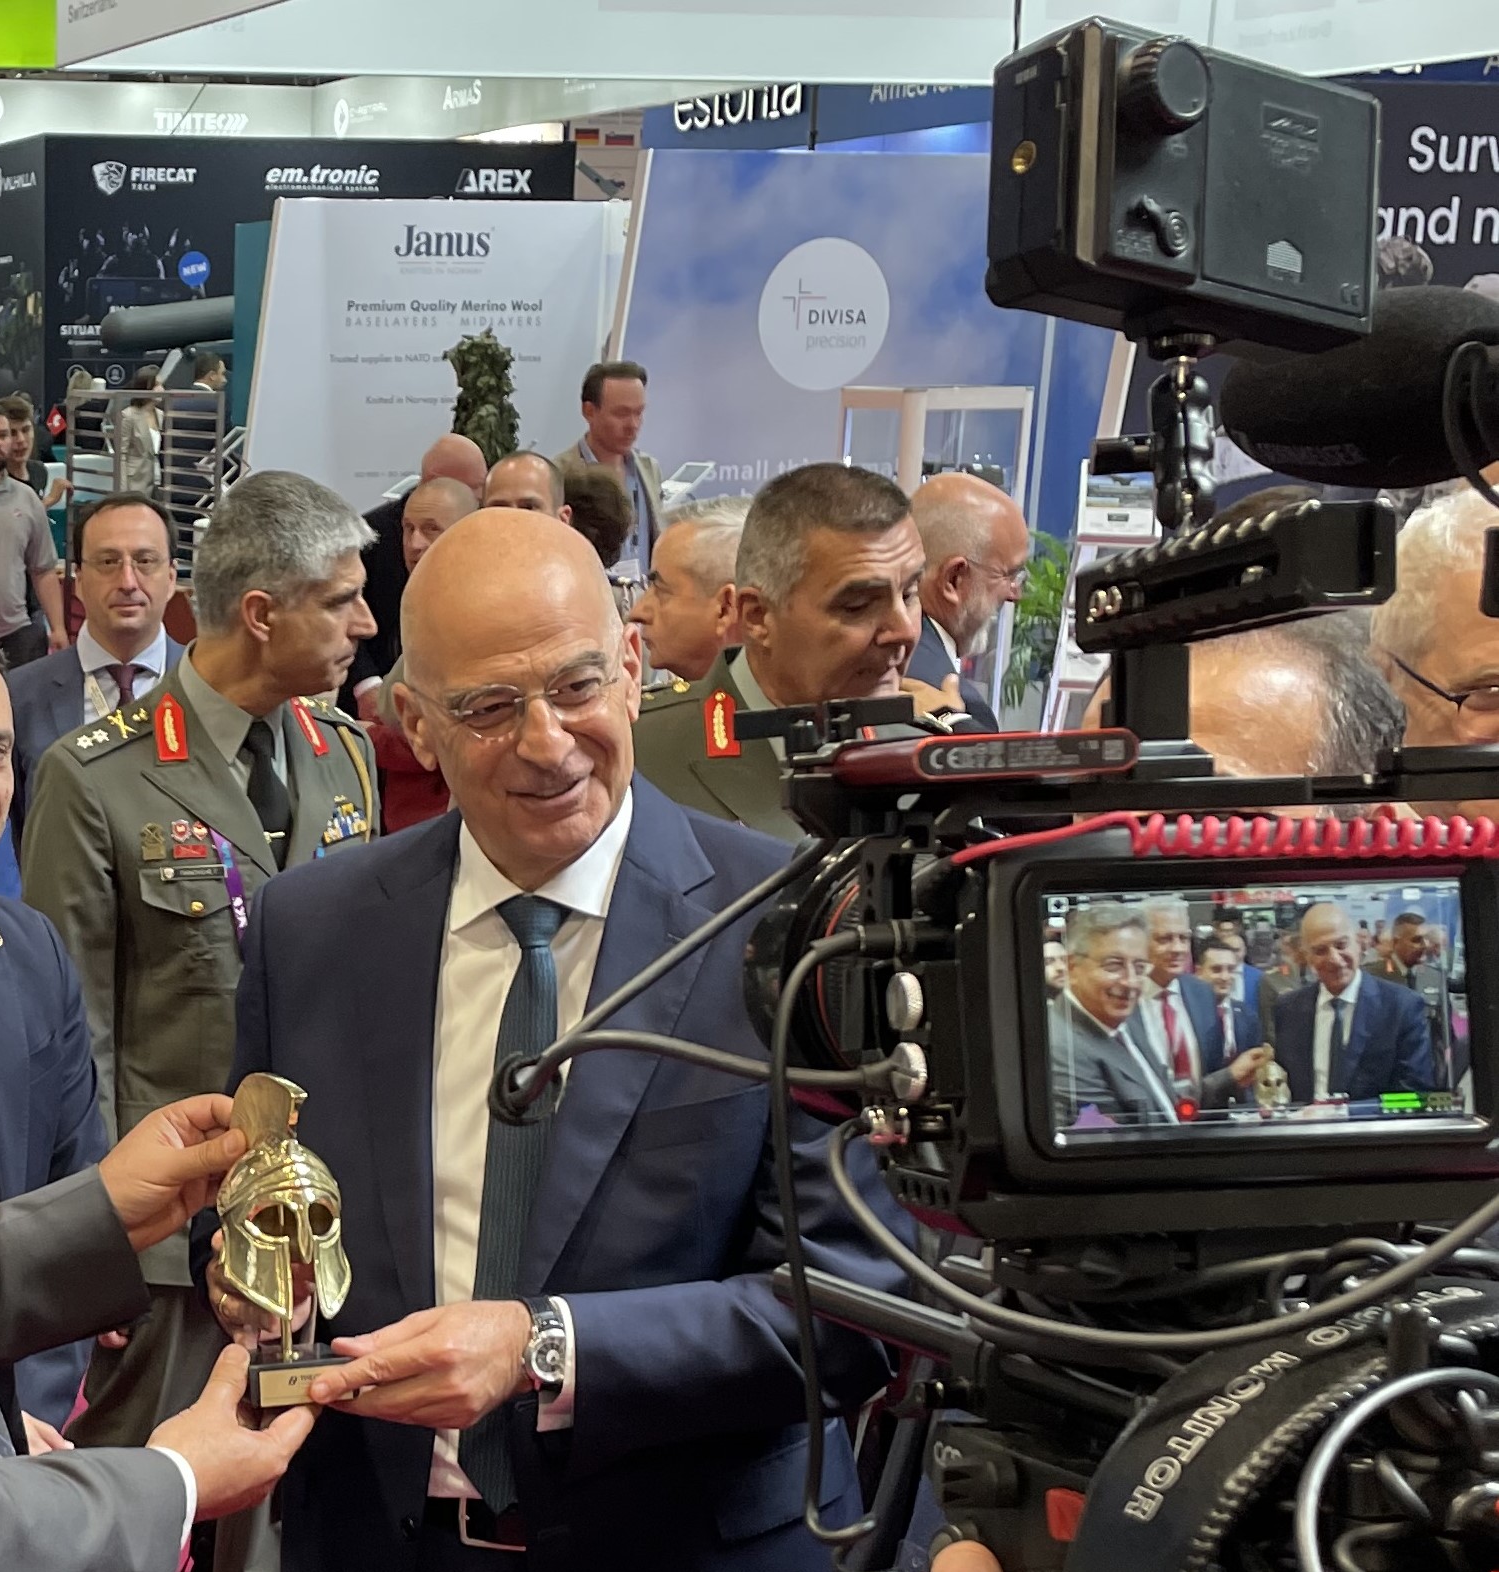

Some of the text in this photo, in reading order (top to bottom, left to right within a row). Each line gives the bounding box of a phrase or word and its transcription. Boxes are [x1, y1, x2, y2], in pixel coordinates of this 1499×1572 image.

[130, 167, 197, 183] FIRECAT
[265, 163, 380, 185] em.tronic
[455, 168, 532, 194] AREX
[394, 224, 491, 257] Janus
[182, 261, 207, 276] NEW
[347, 300, 542, 314] Premium Quality Merino Wool
[346, 316, 541, 328] BASELAYERS MIDLAYERS
[808, 309, 867, 325] DIVISA
[806, 331, 867, 350] precision
[1123, 1350, 1302, 1523] MONITOR
